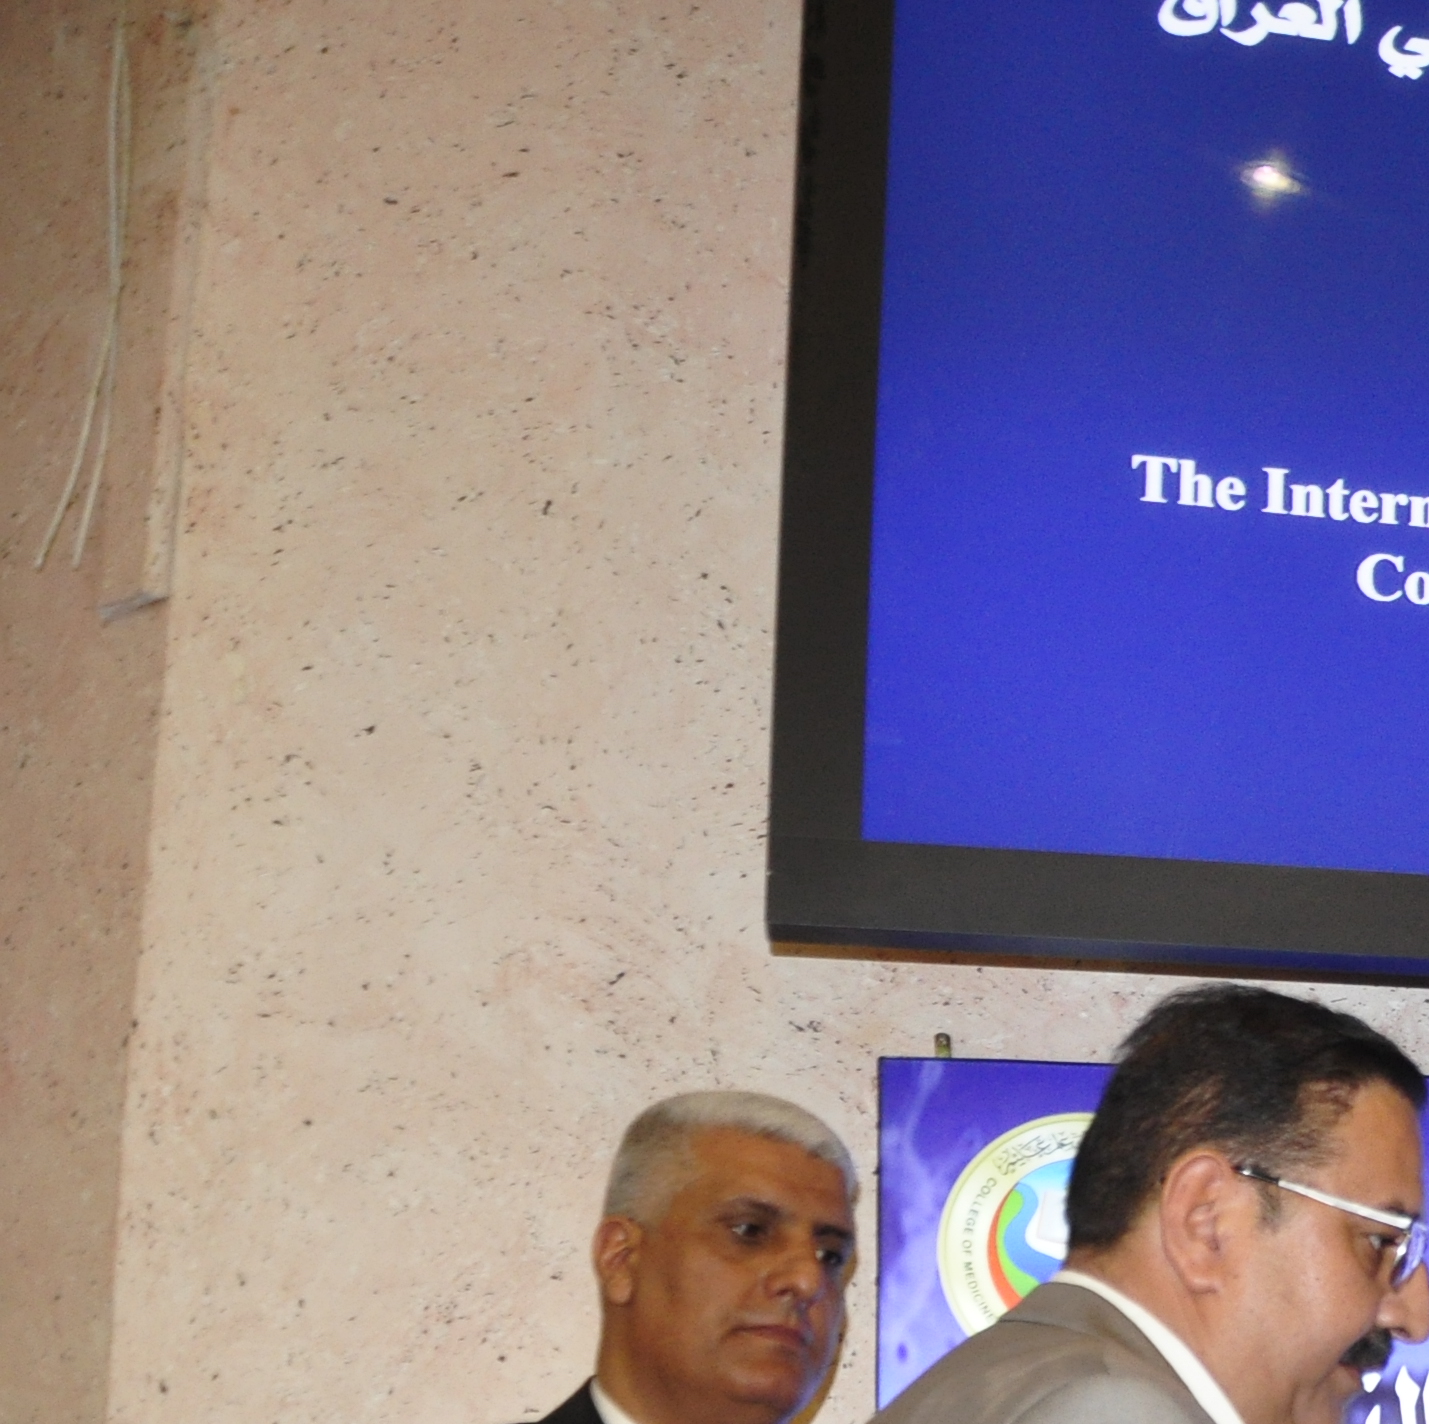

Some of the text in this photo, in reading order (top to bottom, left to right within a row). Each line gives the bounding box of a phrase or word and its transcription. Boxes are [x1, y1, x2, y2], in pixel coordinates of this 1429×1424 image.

[1132, 453, 1247, 512] The
[964, 1177, 997, 1234] COLLEGE
[961, 1239, 972, 1255] OF
